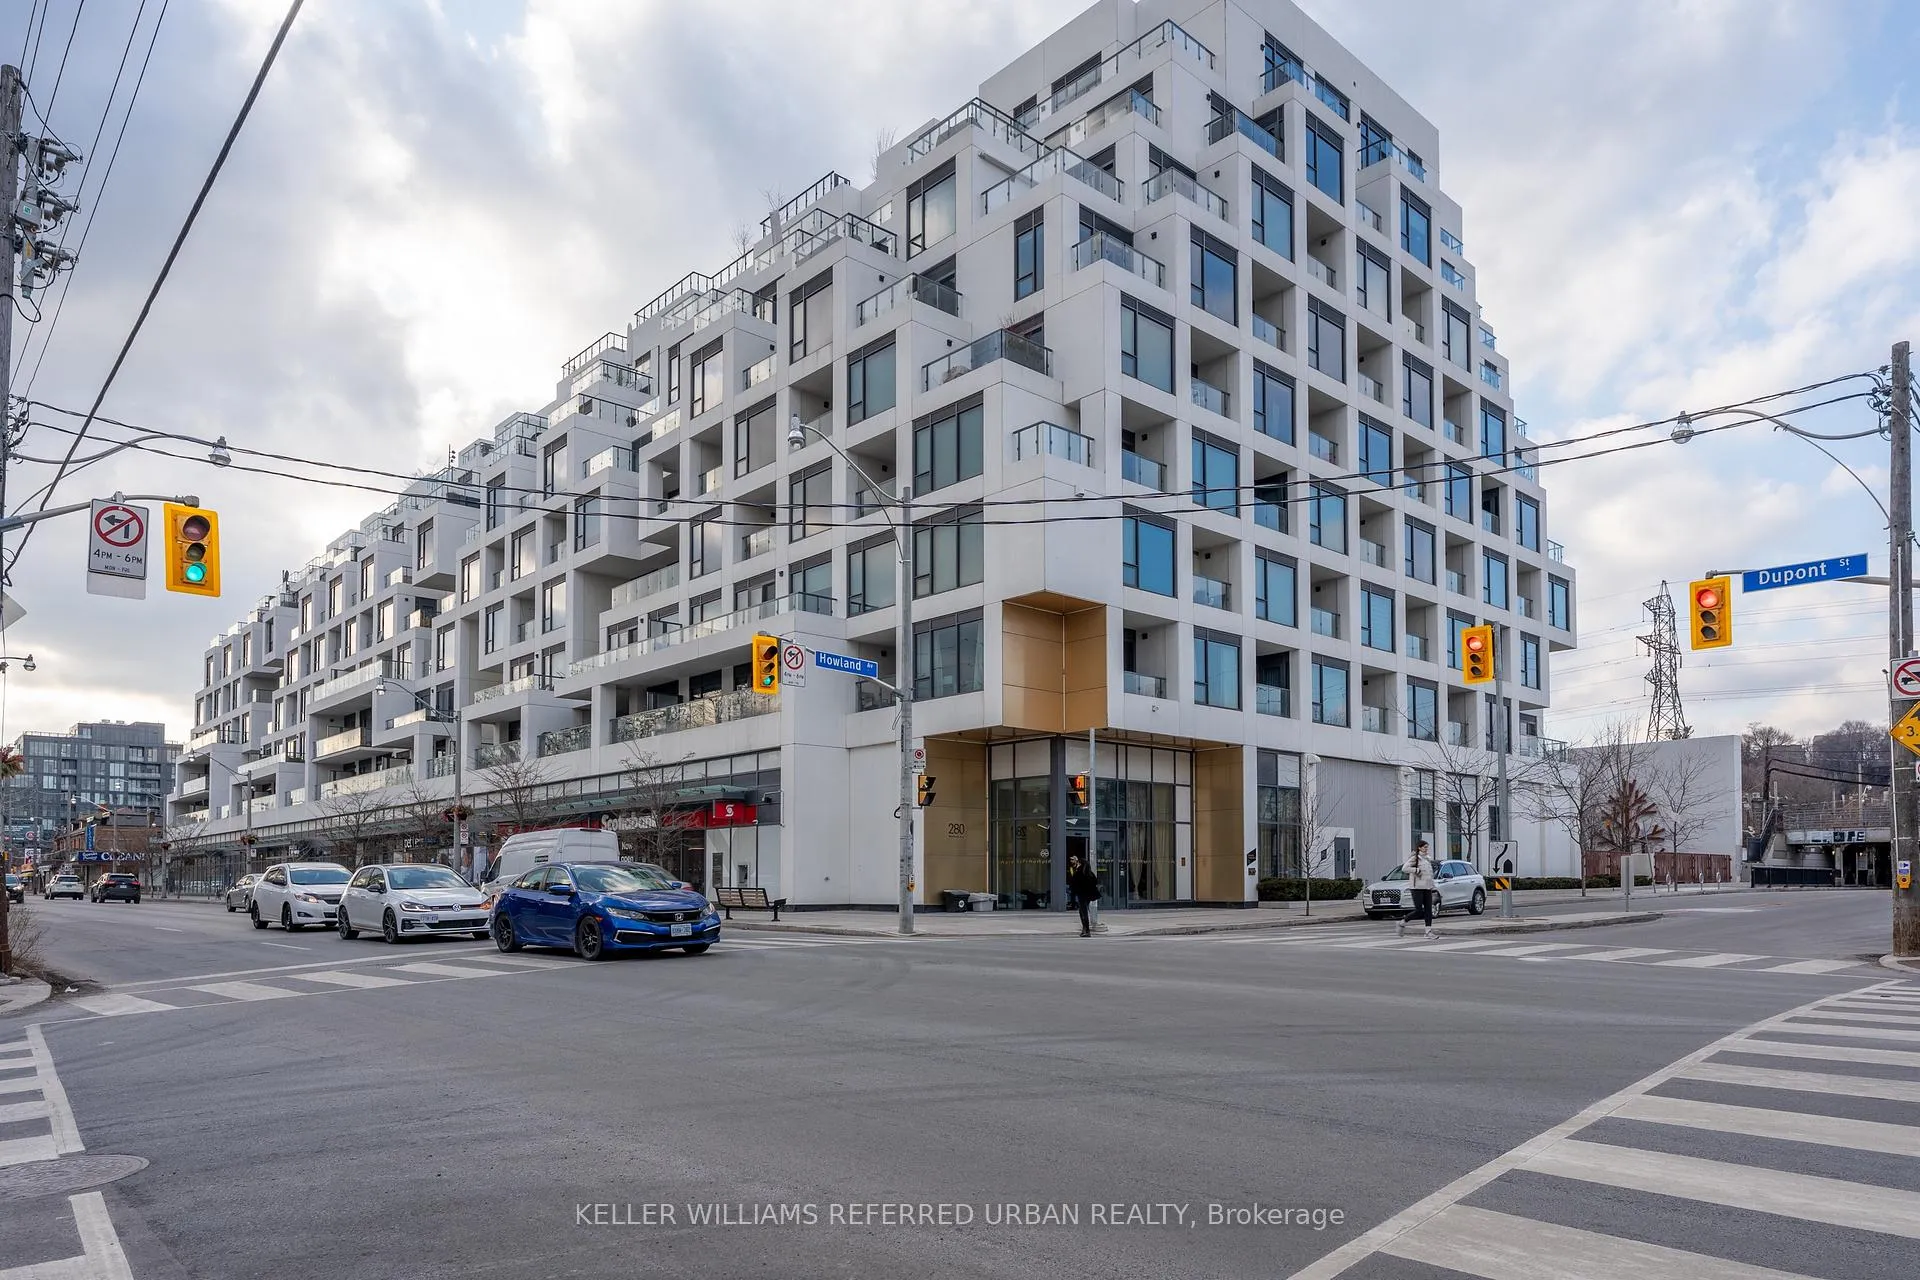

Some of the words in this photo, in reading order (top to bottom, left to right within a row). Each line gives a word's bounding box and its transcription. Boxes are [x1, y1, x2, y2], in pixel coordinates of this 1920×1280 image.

[93, 548, 113, 560] 4PM
[124, 553, 143, 564] 6PM
[1758, 562, 1827, 585] Dupont
[1839, 558, 1850, 567] St
[819, 653, 861, 671] Howland
[601, 811, 658, 831] Scotiabank
[948, 823, 965, 835] 280
